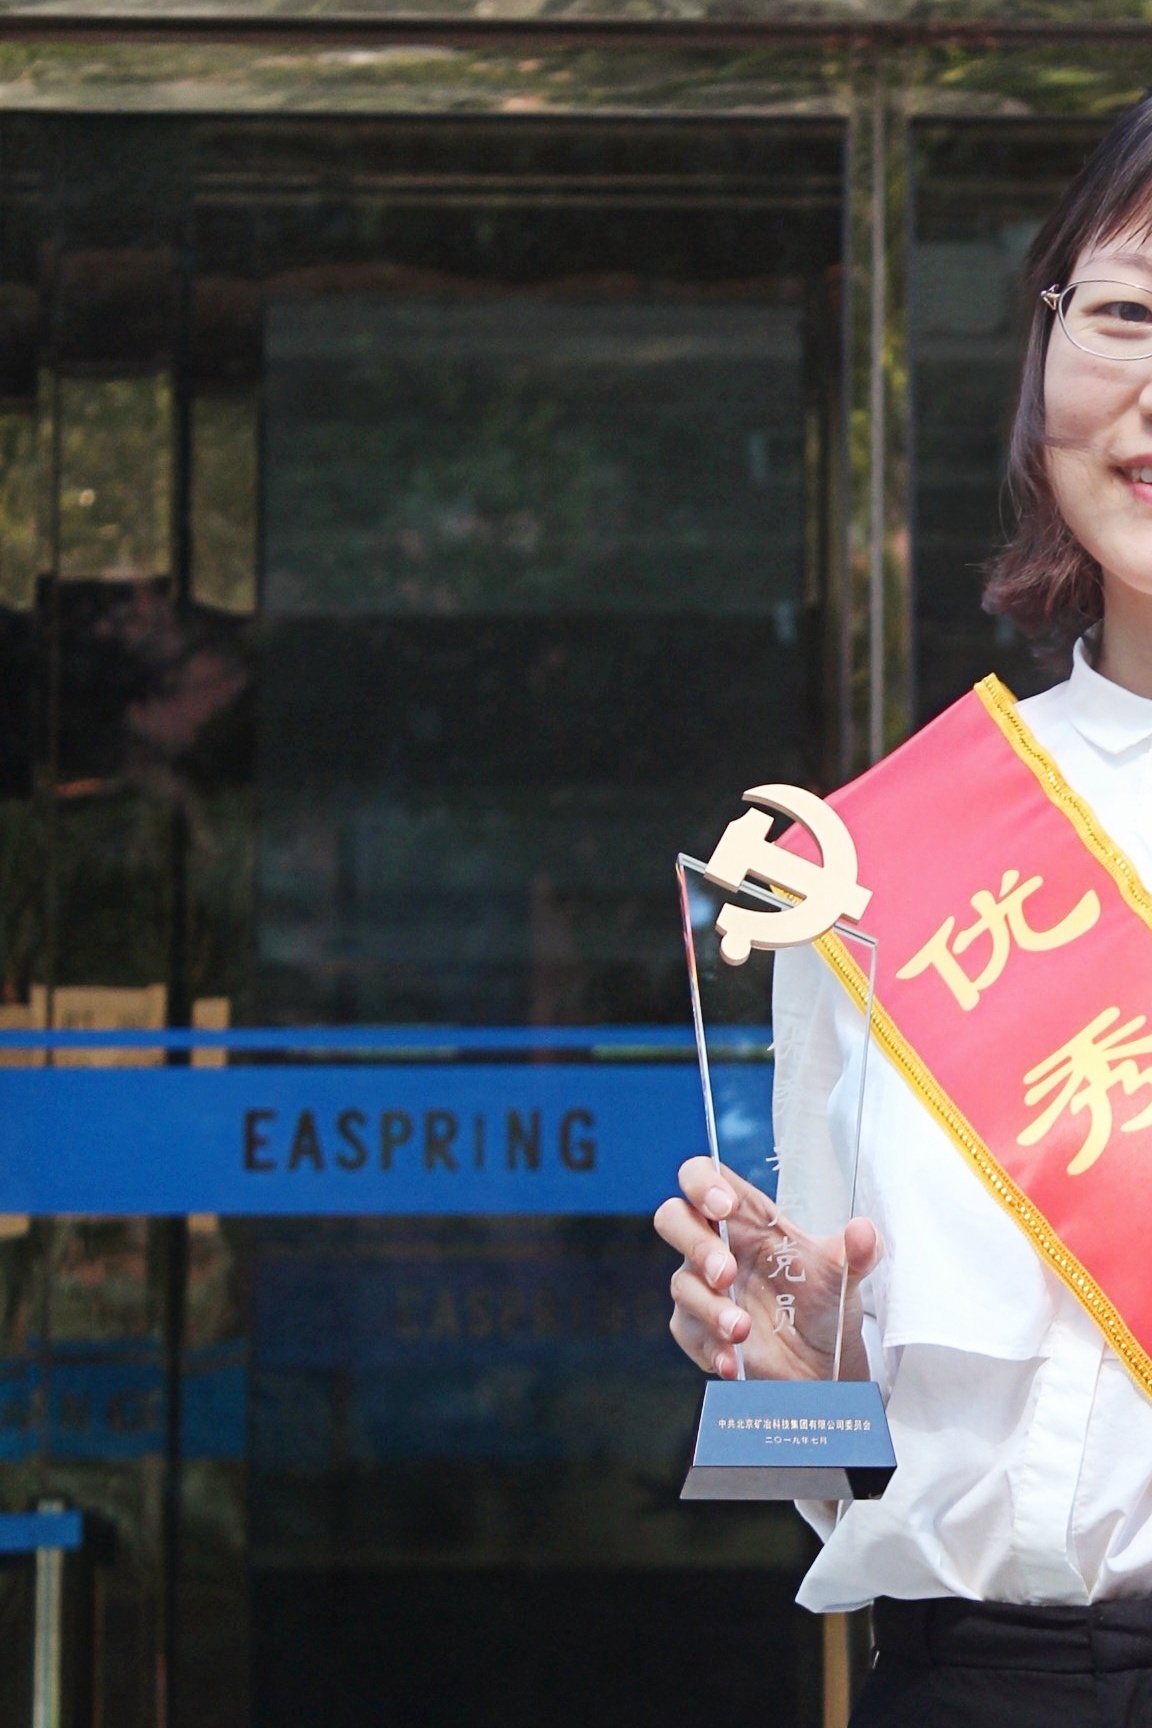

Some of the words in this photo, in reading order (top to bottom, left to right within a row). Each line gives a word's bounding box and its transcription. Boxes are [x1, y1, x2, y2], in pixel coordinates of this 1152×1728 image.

[243, 1108, 597, 1172] EASPRING
[718, 1418, 871, 1431] 中共北京矿冶科技集团有限公司委员会
